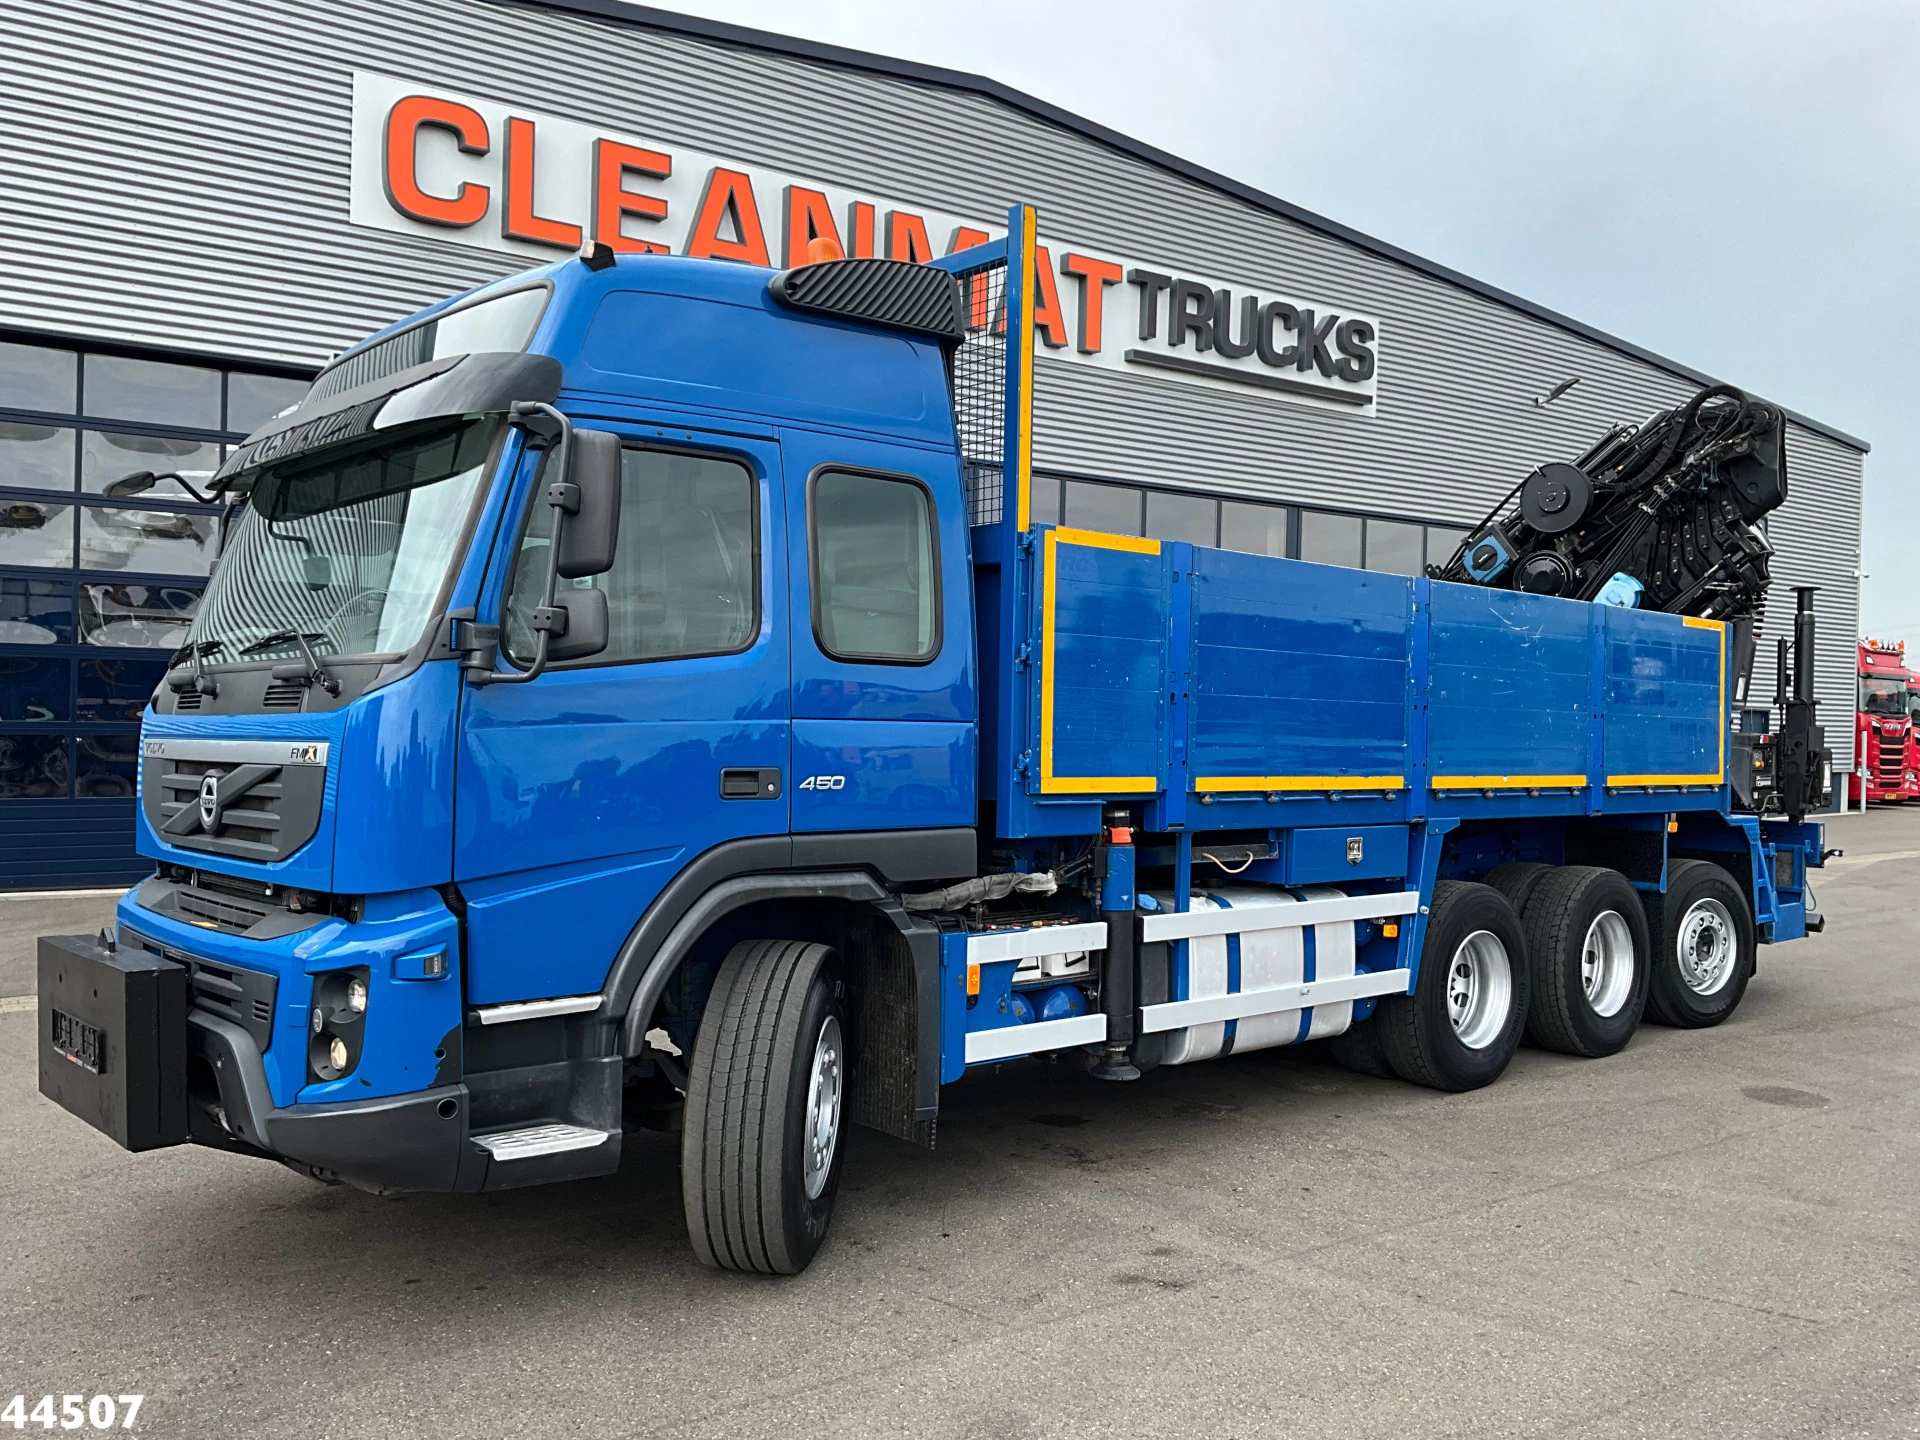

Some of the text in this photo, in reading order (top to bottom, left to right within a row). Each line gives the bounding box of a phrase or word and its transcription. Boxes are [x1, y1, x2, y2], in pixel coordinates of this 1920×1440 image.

[1127, 268, 1375, 382] TRUCKS
[290, 746, 318, 762] FMX
[799, 775, 846, 791] 450
